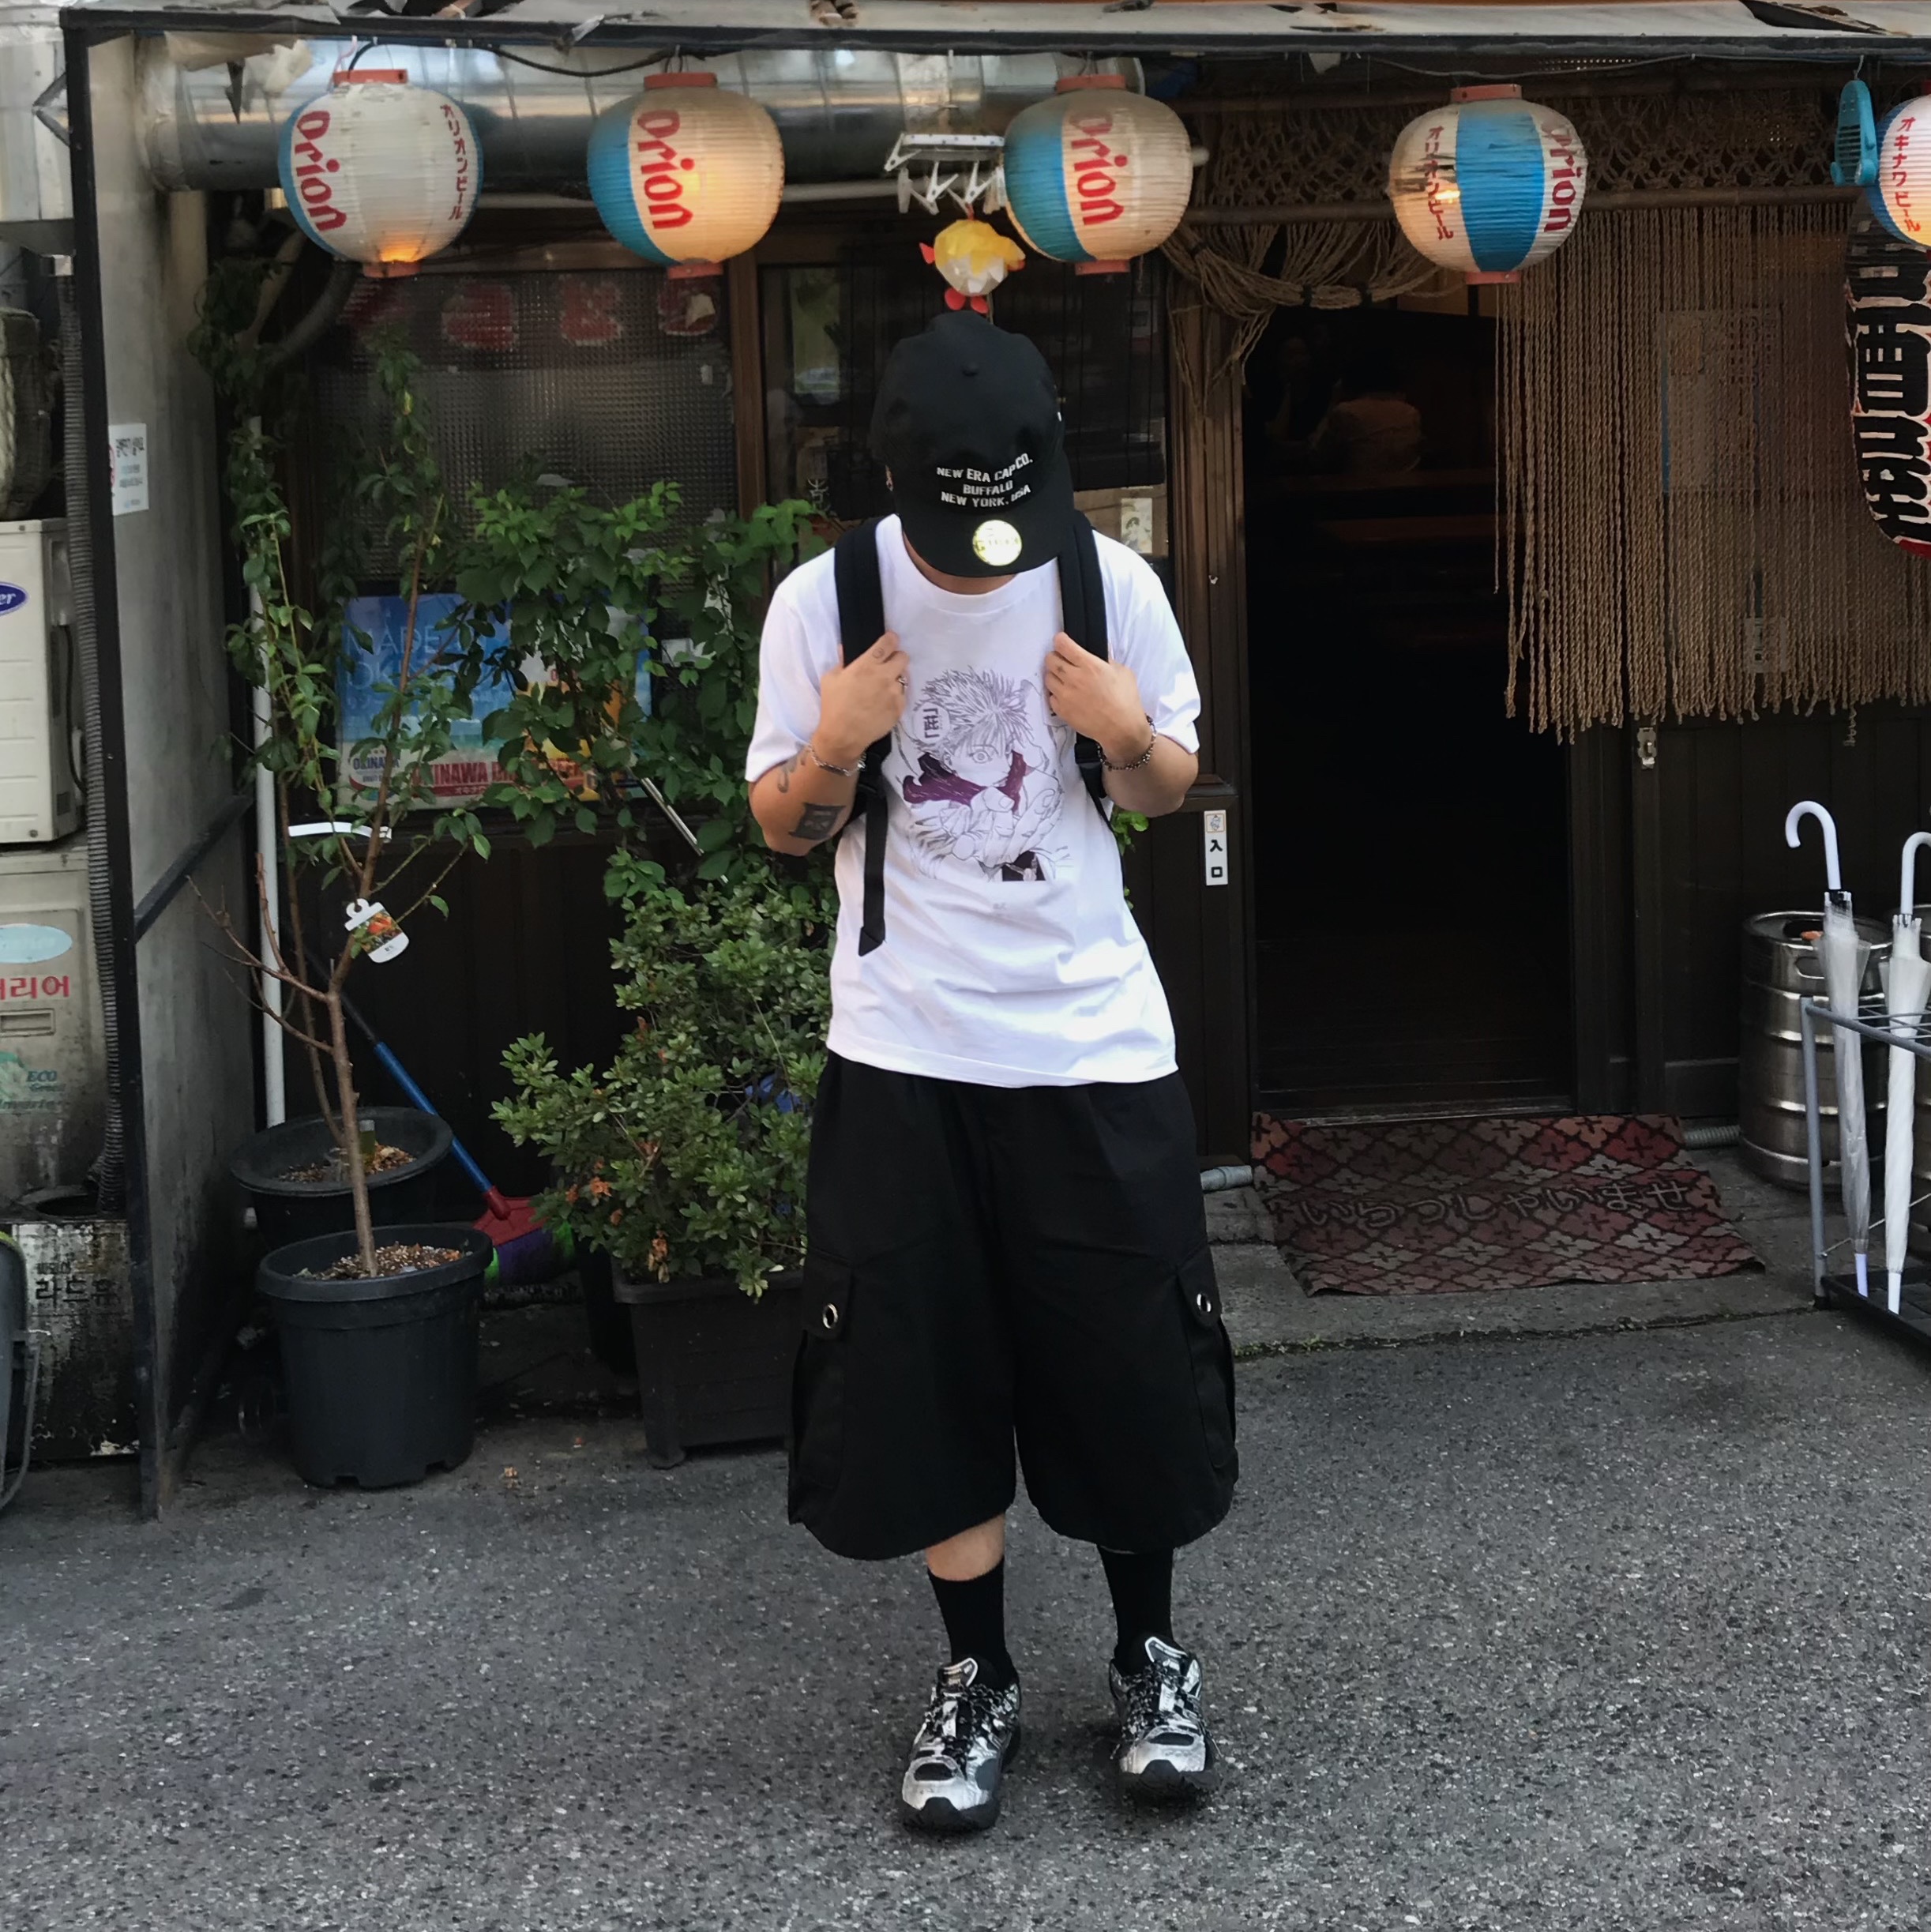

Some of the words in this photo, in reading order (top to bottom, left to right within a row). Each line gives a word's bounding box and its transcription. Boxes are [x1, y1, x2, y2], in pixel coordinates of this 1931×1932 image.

[440, 103, 468, 221] オリオンビール
[1892, 116, 1922, 232] オキナワビール
[937, 467, 964, 479] NEW
[966, 468, 990, 483] ERA
[994, 464, 1016, 481] CAP
[1015, 453, 1033, 469] CO.
[941, 491, 967, 506] NEW
[1010, 484, 1031, 502] USA
[962, 480, 1013, 495] BUFFALO
[1209, 840, 1223, 878] 入口
